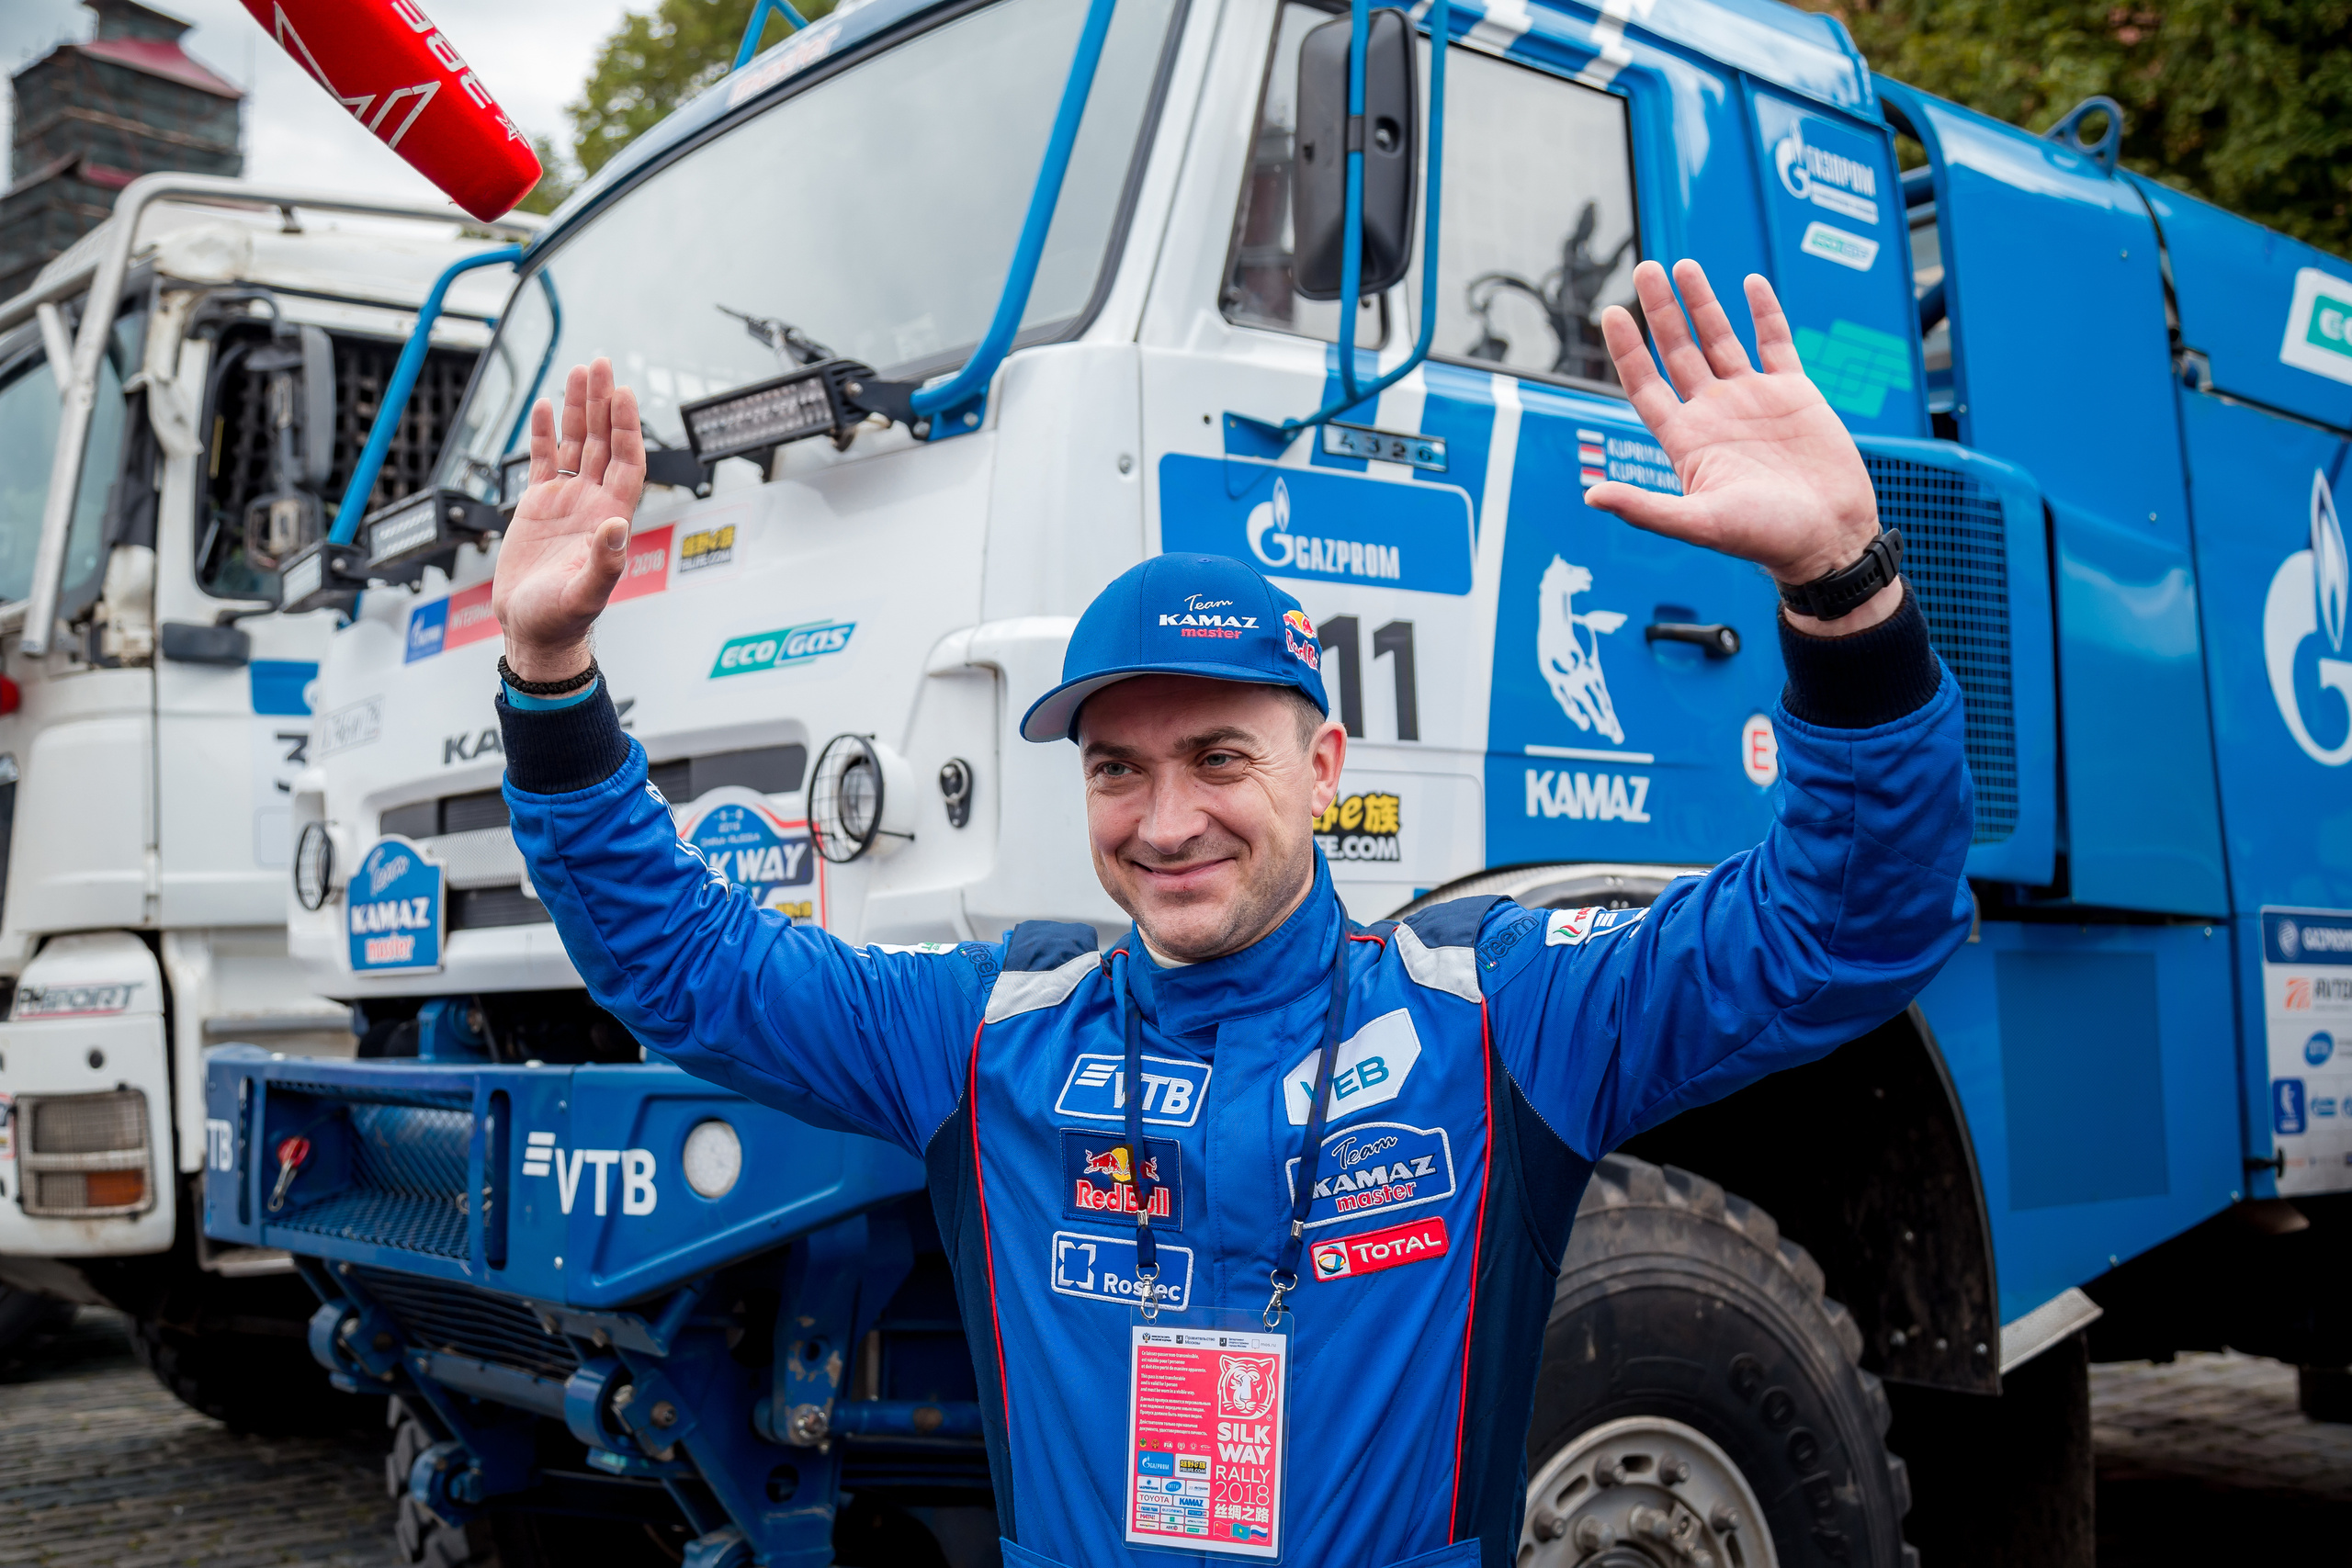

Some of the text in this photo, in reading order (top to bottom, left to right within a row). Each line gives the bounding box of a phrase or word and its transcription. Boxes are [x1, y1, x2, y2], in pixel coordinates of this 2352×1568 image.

[1295, 535, 1400, 580] GAZPROM
[1184, 593, 1233, 611] Team
[1159, 614, 1260, 628] KAMAZ
[1181, 627, 1242, 638] master
[1753, 731, 1769, 770] E
[1525, 769, 1651, 823] KAMAZ
[736, 842, 807, 883] WAY
[351, 897, 430, 935] KAMAZ
[367, 932, 414, 964] master
[1331, 1136, 1398, 1169] Team
[555, 1149, 657, 1216] VTB
[1312, 1153, 1436, 1200] KAMAZ
[1336, 1182, 1417, 1213] master
[1351, 1233, 1442, 1263] TOTAL
[1103, 1272, 1182, 1301] Rosec
[1217, 1422, 1272, 1445] SILK
[1217, 1442, 1271, 1465] WAY
[1216, 1465, 1270, 1483] RALLY
[1140, 1495, 1170, 1503] TOYOTA
[1180, 1498, 1204, 1507] KAMAZ
[1215, 1481, 1270, 1506] 2018
